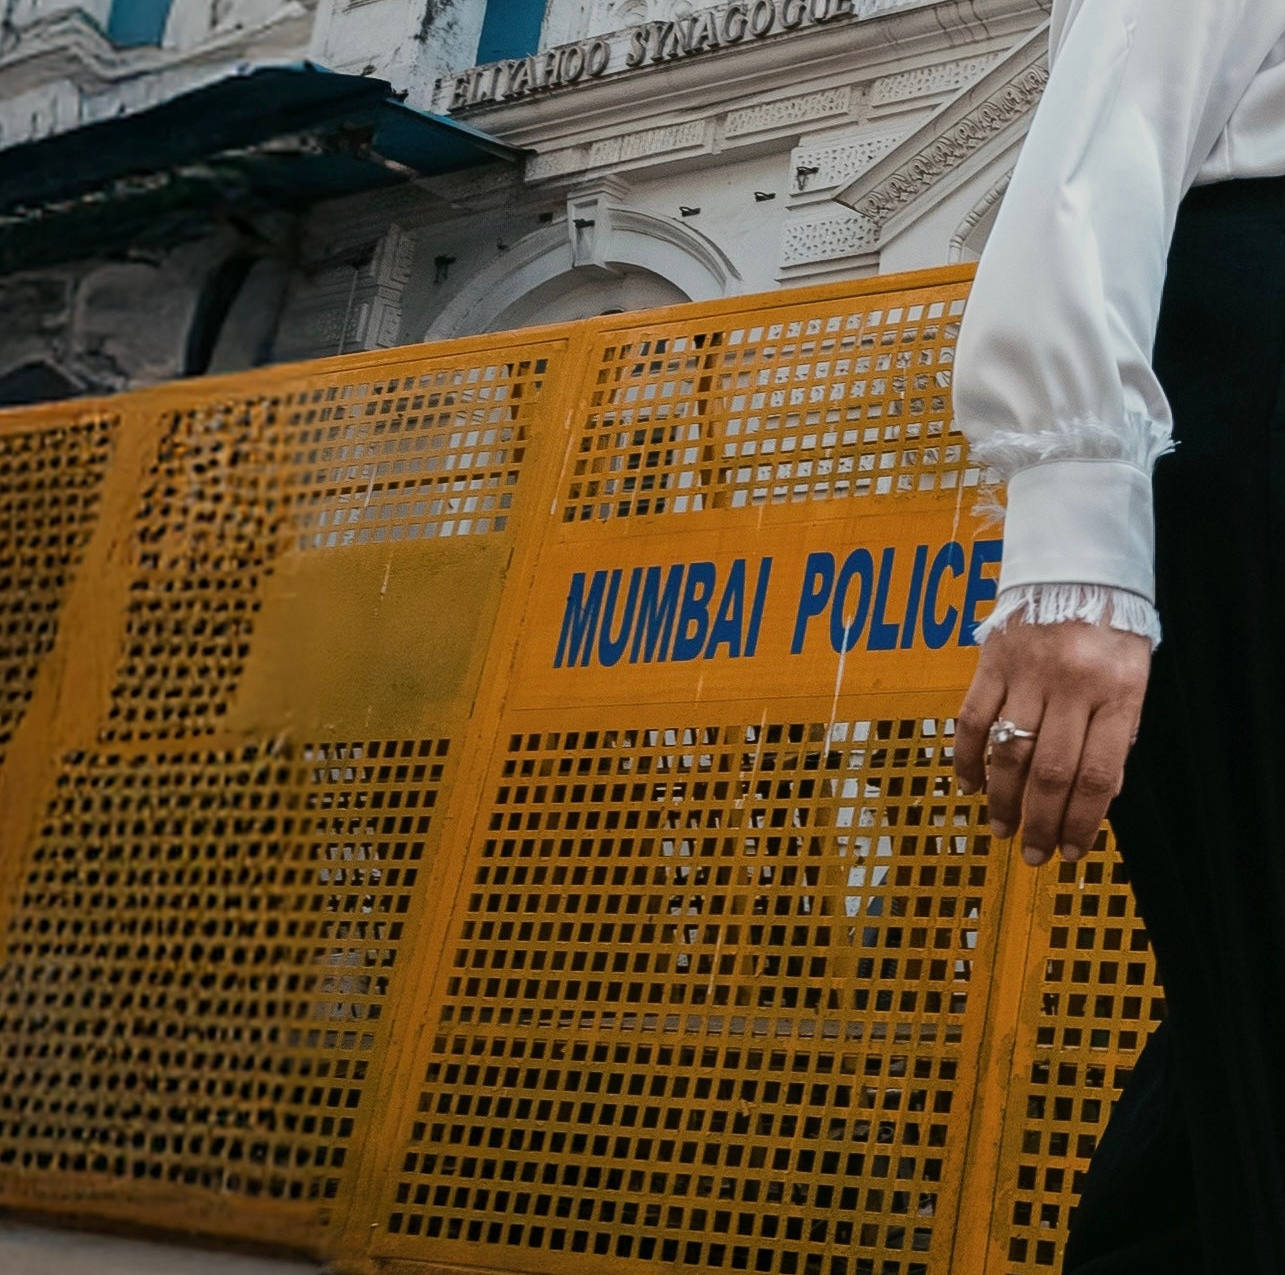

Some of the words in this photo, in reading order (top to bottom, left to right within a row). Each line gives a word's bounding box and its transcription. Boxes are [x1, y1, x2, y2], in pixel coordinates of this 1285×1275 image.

[447, 38, 612, 112] ELIYAHOO
[553, 556, 773, 669] MUMBAI
[790, 538, 1004, 654] POLICE
